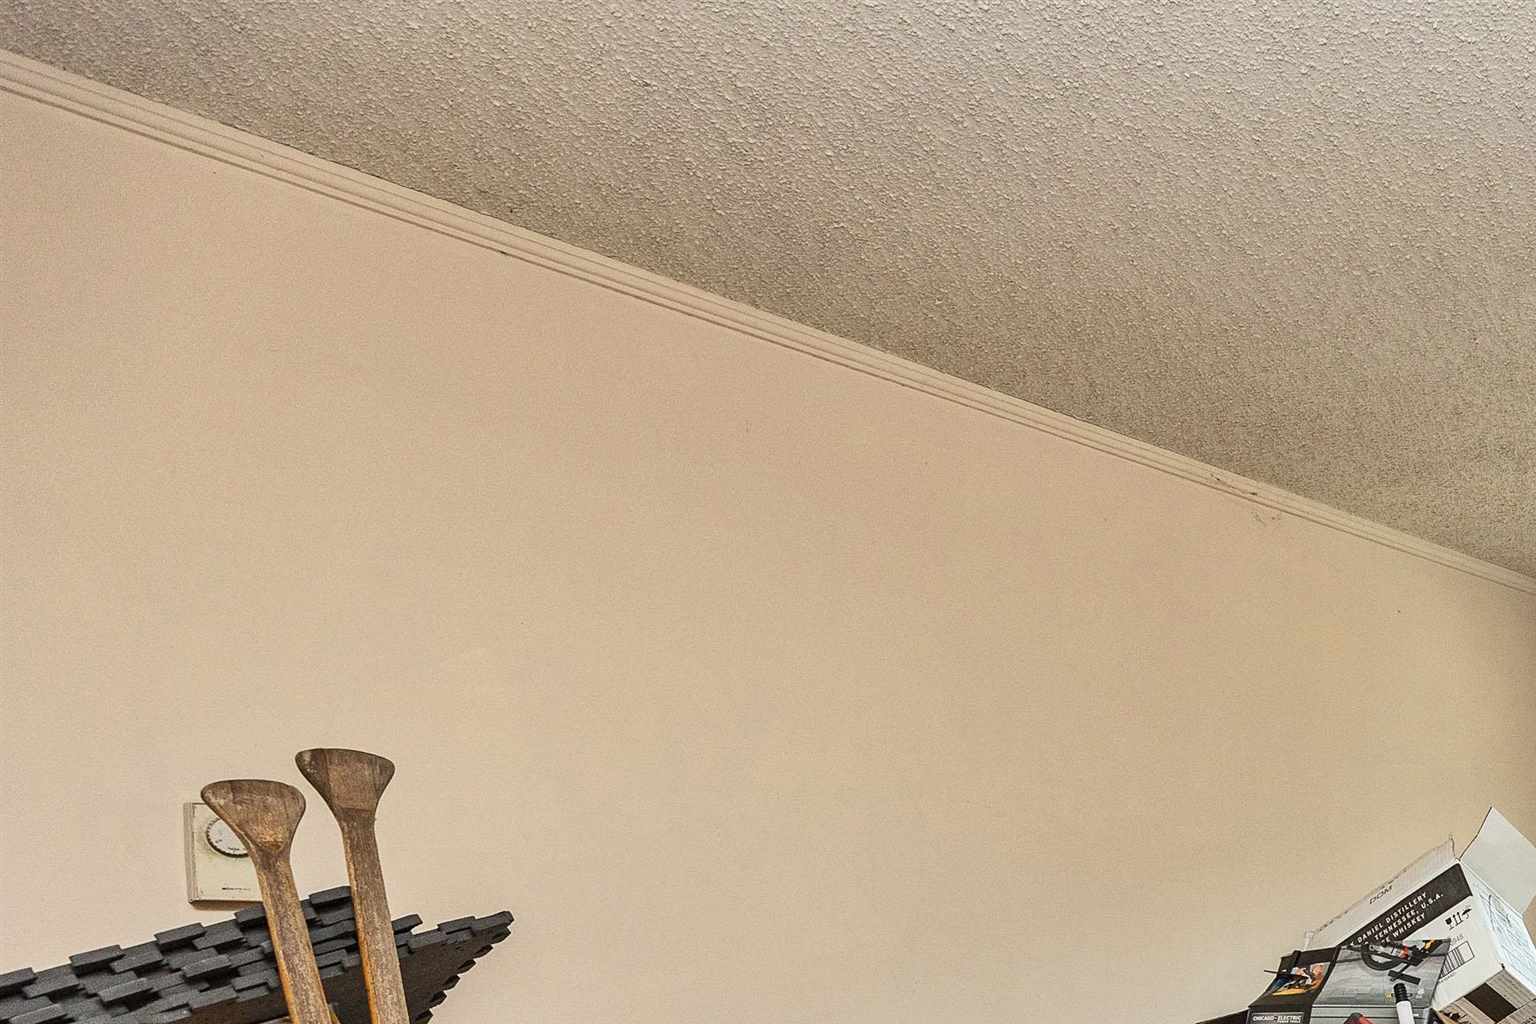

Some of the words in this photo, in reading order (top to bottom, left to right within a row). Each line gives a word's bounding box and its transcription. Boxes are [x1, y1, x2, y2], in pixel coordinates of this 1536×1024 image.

[1358, 922, 1384, 943] DANIEL
[1386, 892, 1427, 923] DISTILLERY
[1393, 913, 1426, 938] WHISKEY
